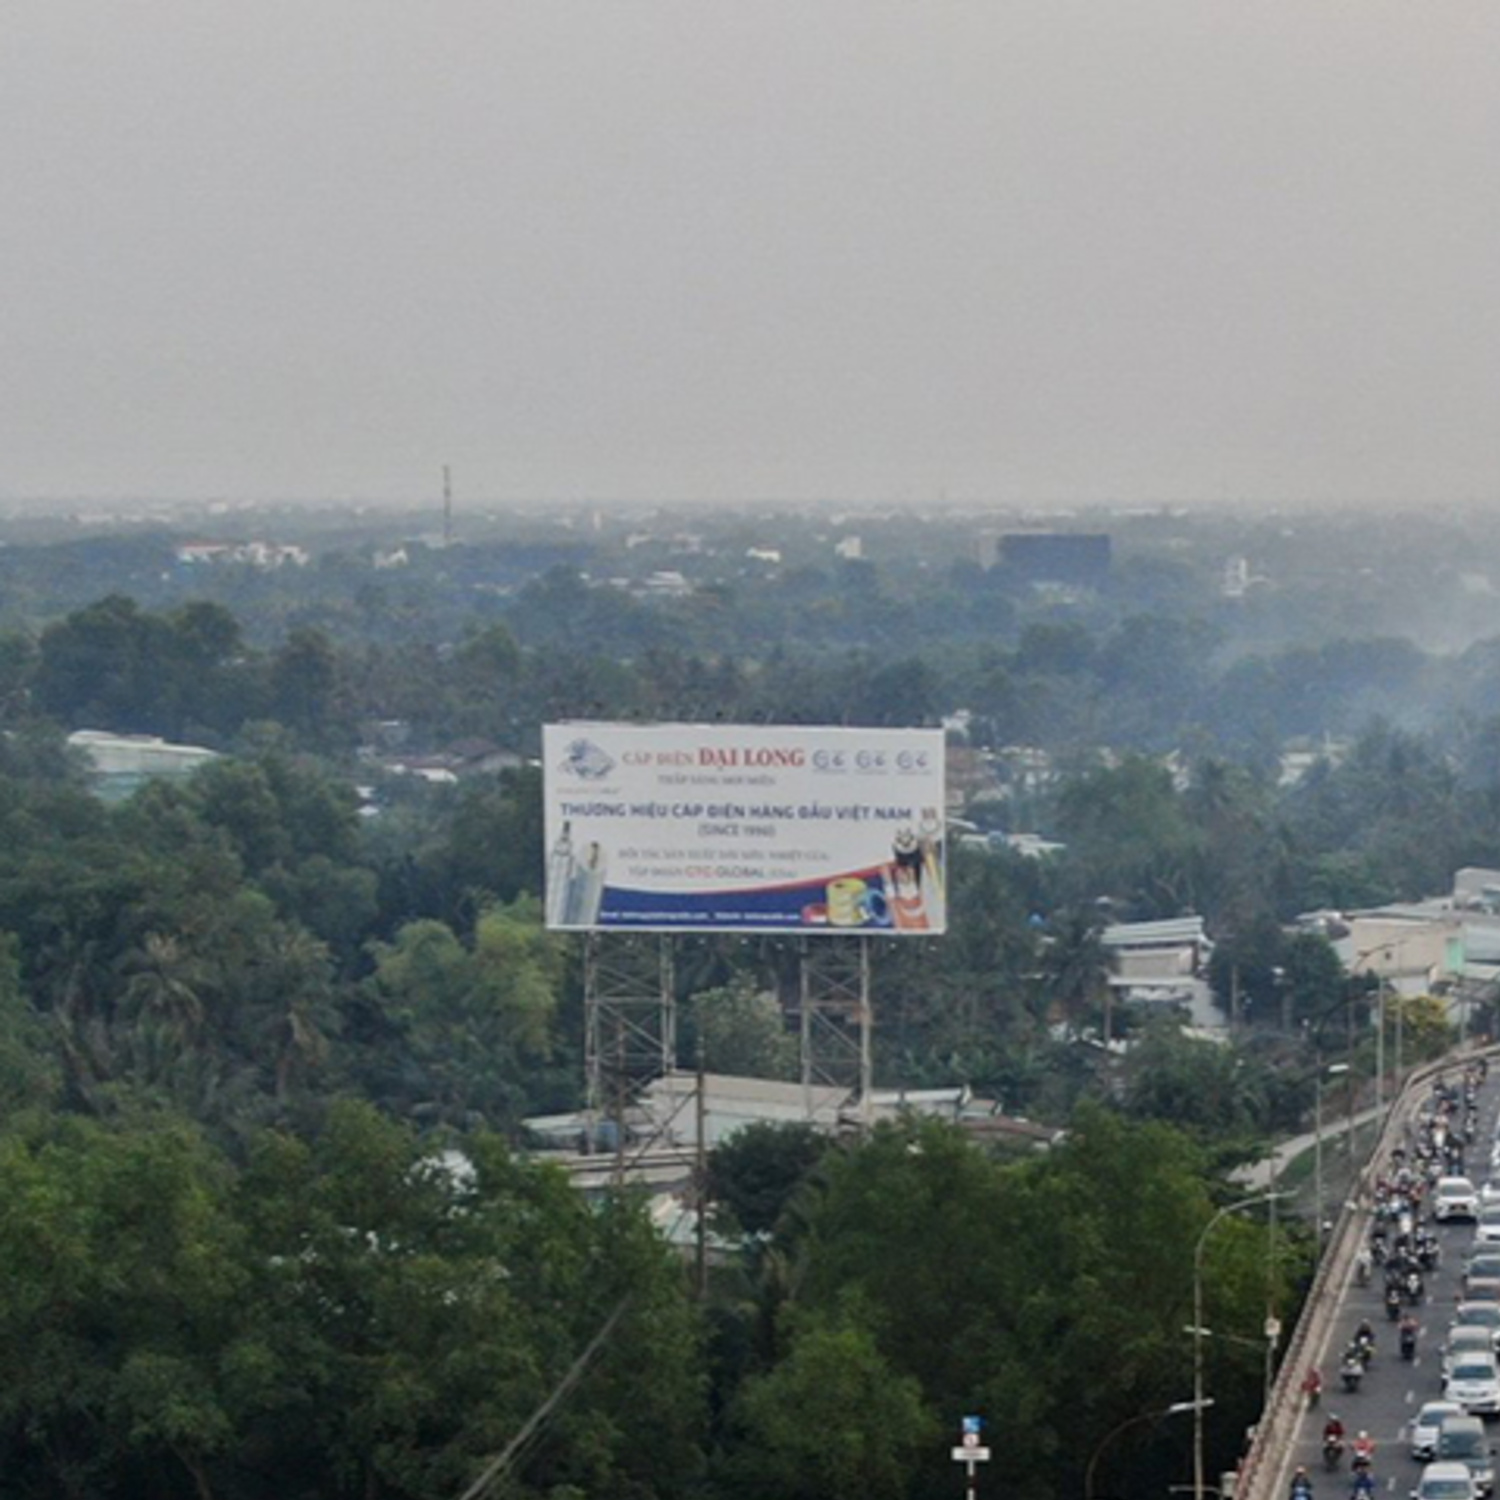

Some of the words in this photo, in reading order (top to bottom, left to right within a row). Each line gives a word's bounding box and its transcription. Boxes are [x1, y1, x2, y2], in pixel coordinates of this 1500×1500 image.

[699, 747, 737, 771] ĐẠI
[744, 747, 804, 767] LONG
[874, 805, 912, 820] NAM
